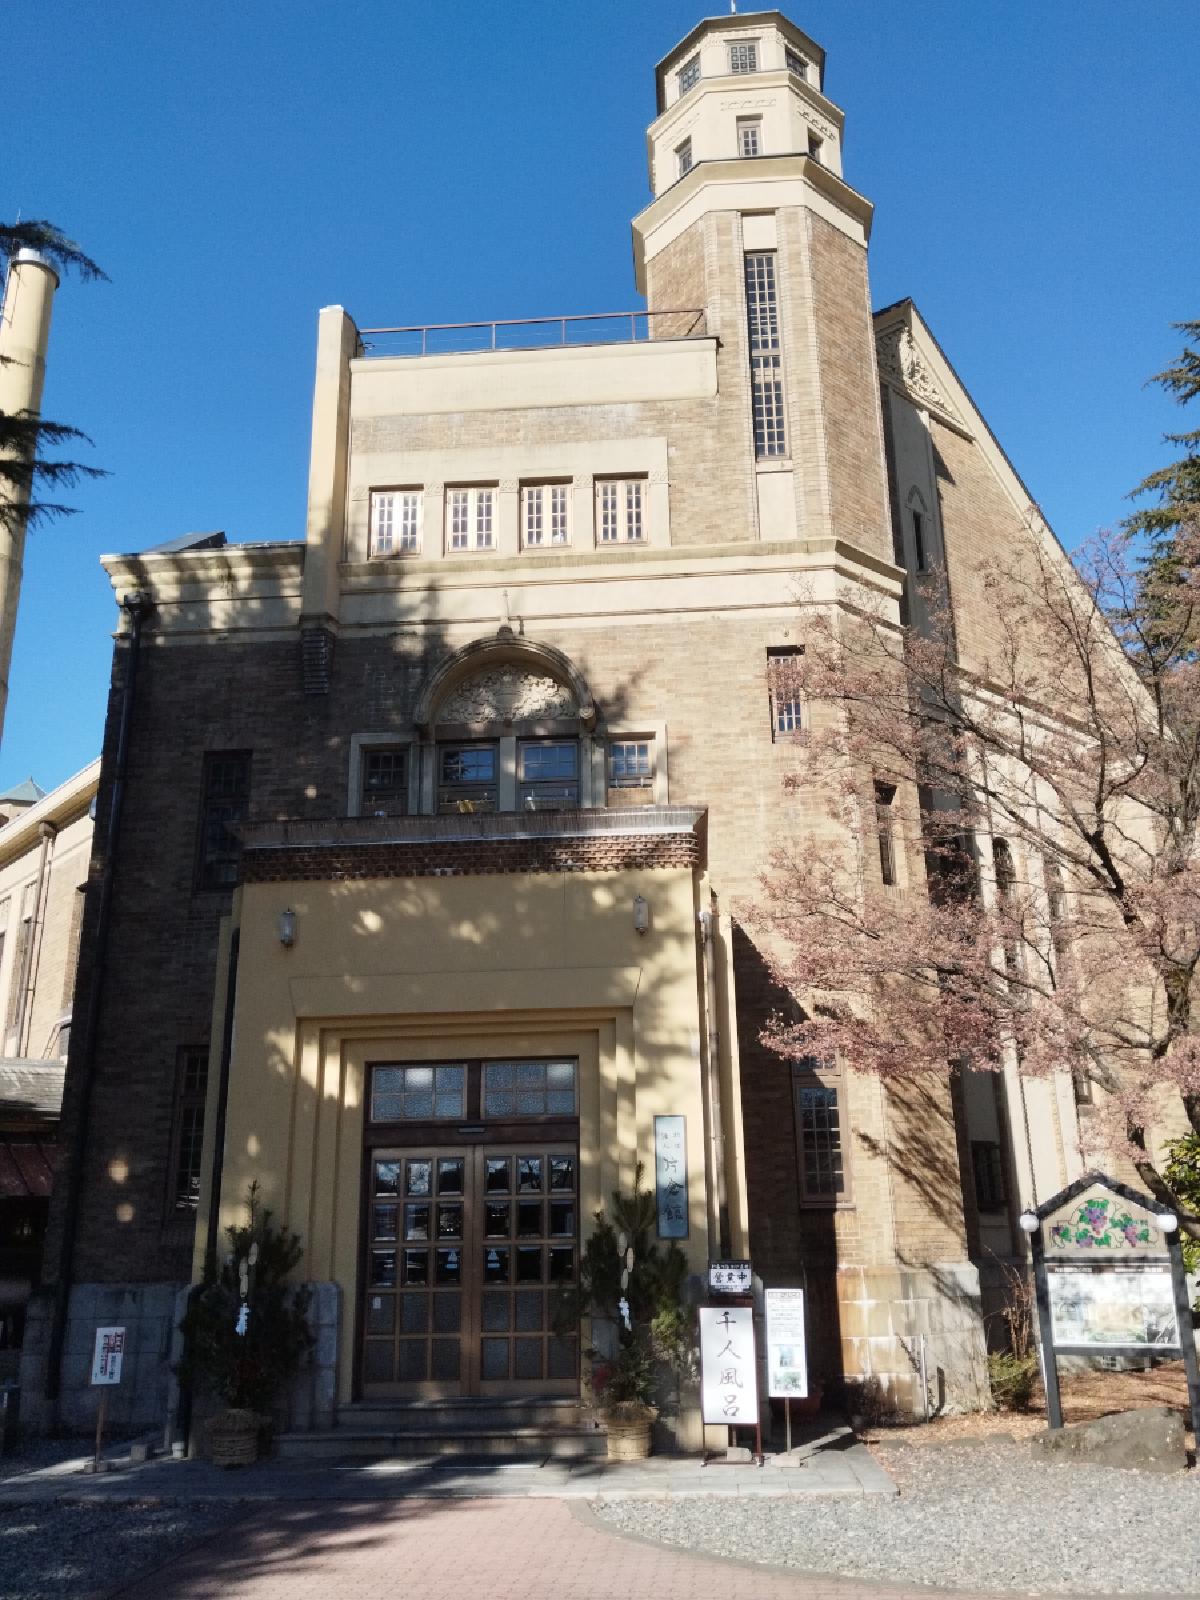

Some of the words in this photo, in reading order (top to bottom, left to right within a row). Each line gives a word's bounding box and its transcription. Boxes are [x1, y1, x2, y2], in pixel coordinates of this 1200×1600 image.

[713, 1271, 748, 1284] 営業中
[716, 1311, 744, 1417] 千人風呂
